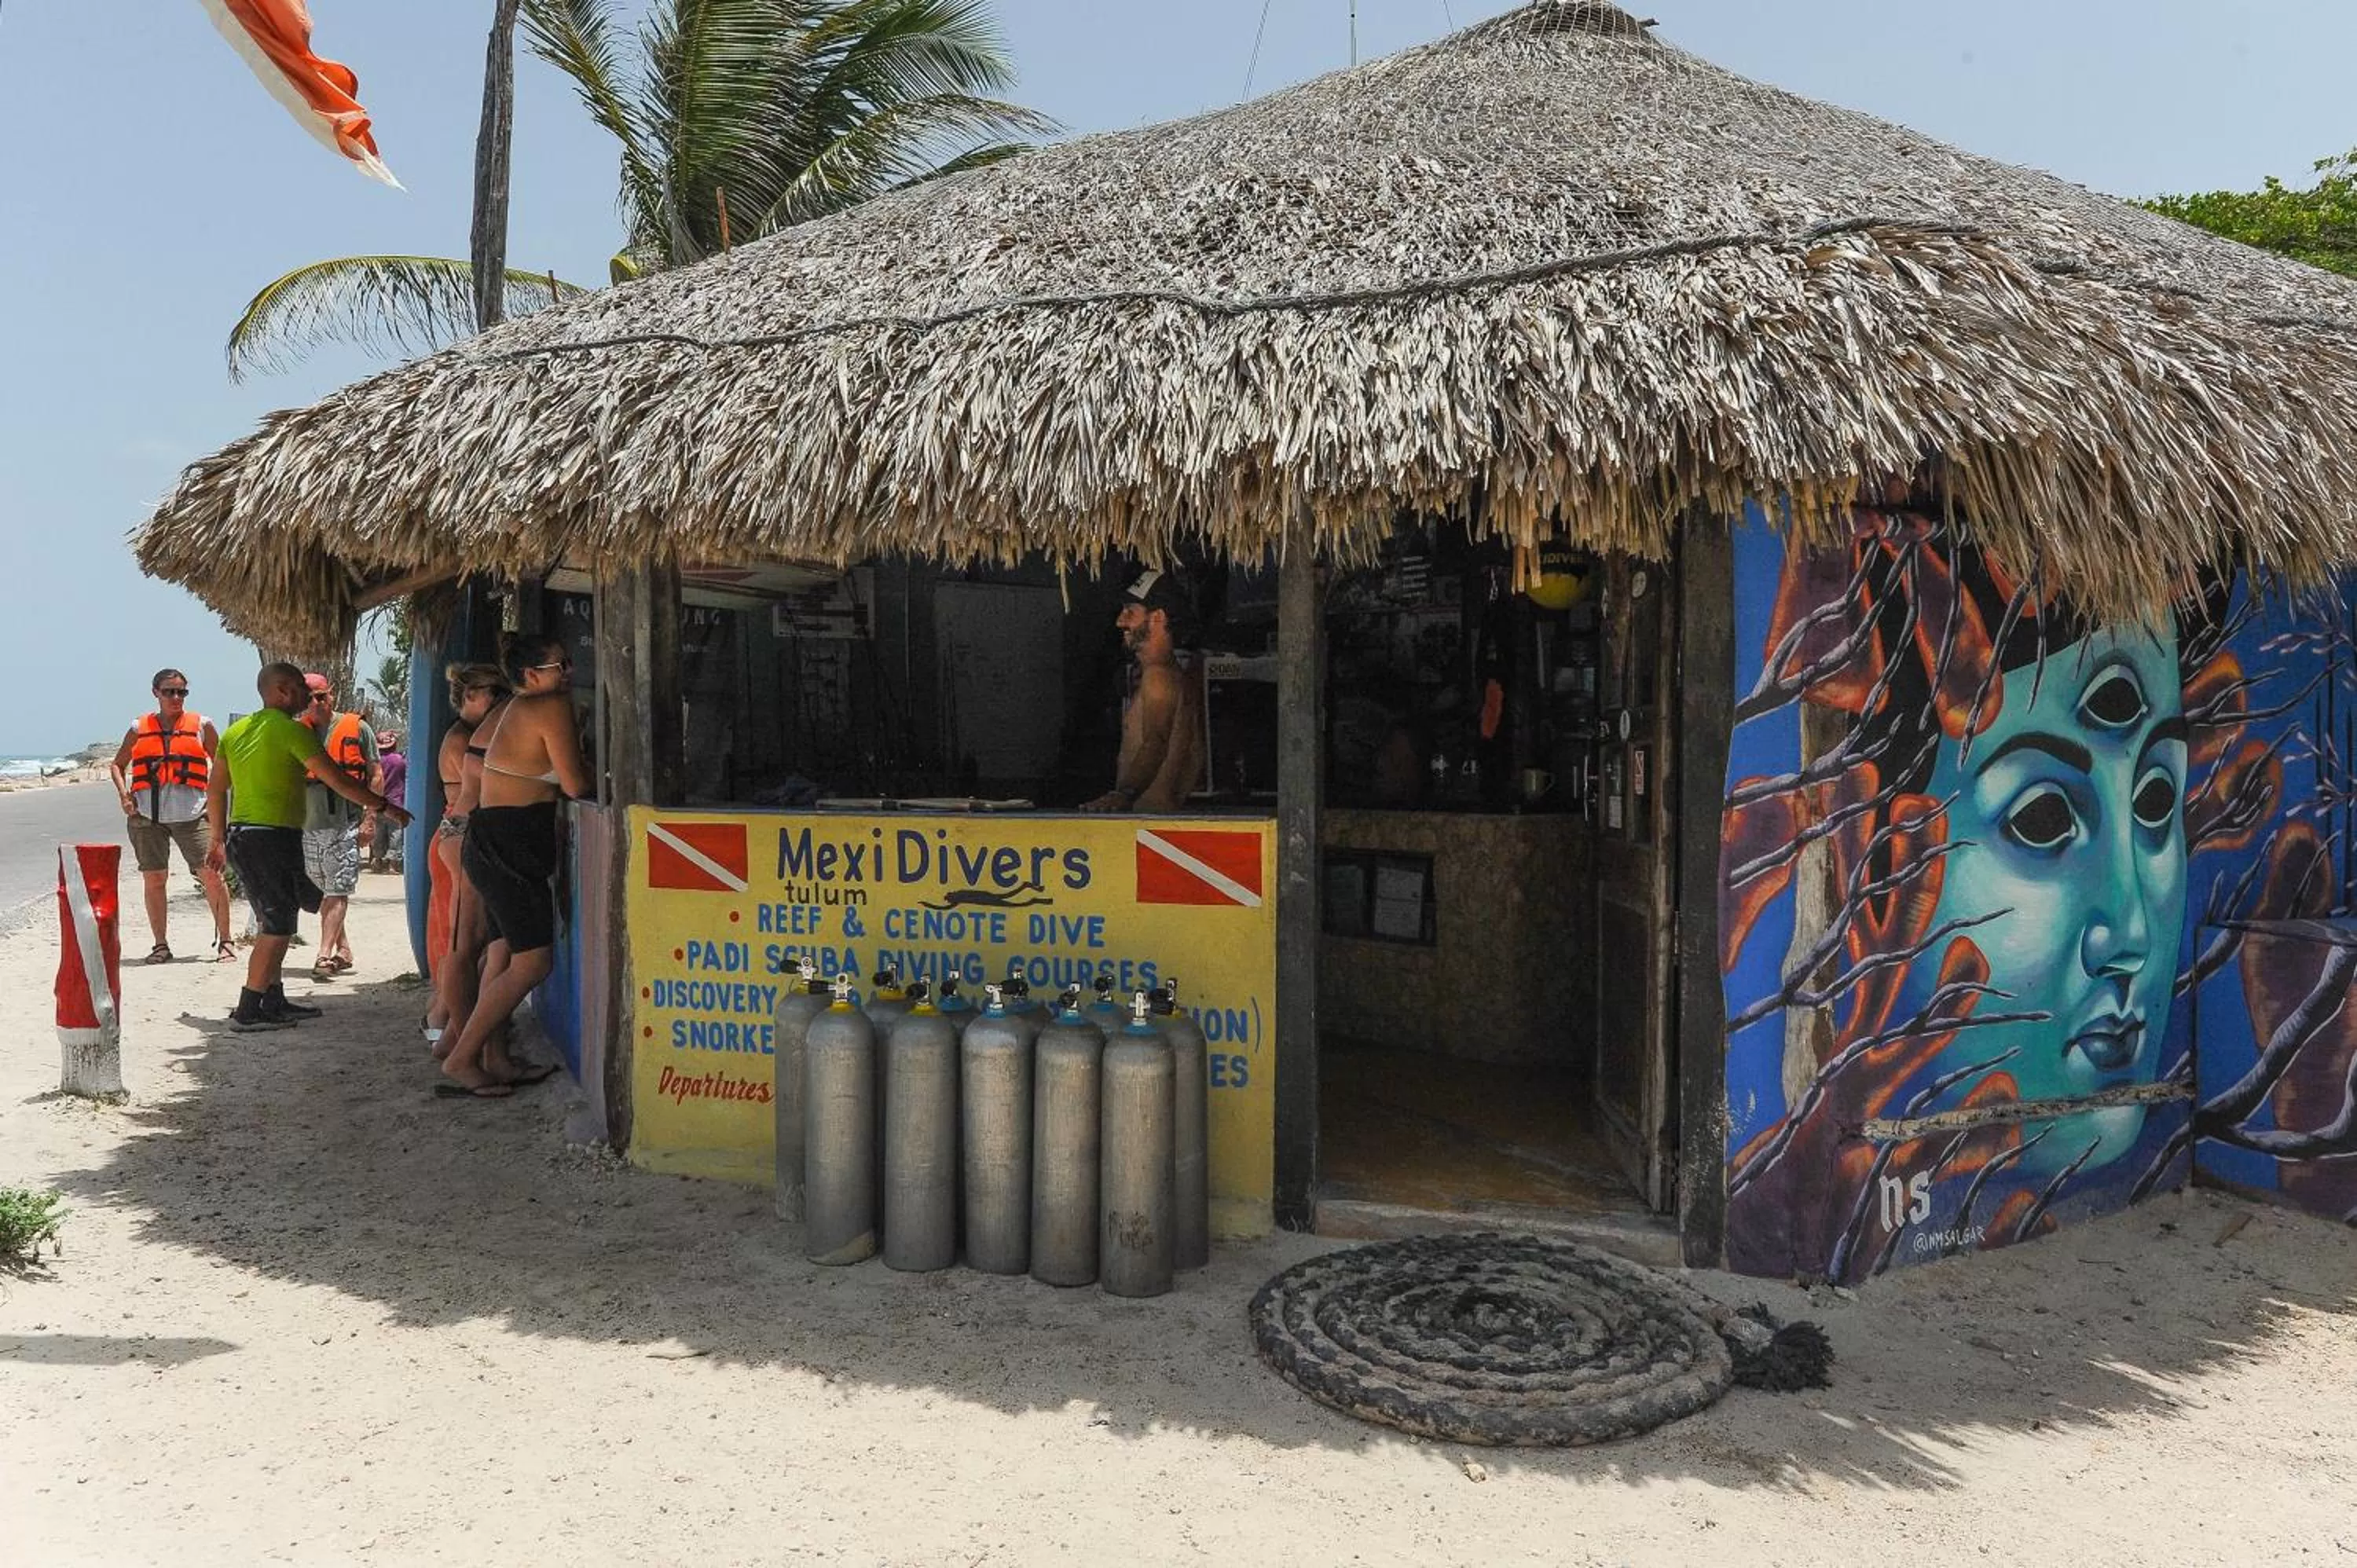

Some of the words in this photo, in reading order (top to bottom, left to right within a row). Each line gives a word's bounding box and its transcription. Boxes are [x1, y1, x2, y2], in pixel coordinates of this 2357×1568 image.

[785, 880, 867, 905] tulum
[758, 904, 822, 934] REEF
[842, 906, 866, 938] &
[885, 908, 1006, 943] CENOTE
[1028, 914, 1105, 948] DIVE
[687, 940, 749, 972] PADI
[878, 949, 984, 986] DIVING
[1007, 955, 1157, 994] COURSES
[653, 980, 777, 1015] DISCOVERY
[672, 1020, 775, 1055] SNORKE
[658, 1065, 775, 1106] Departures
